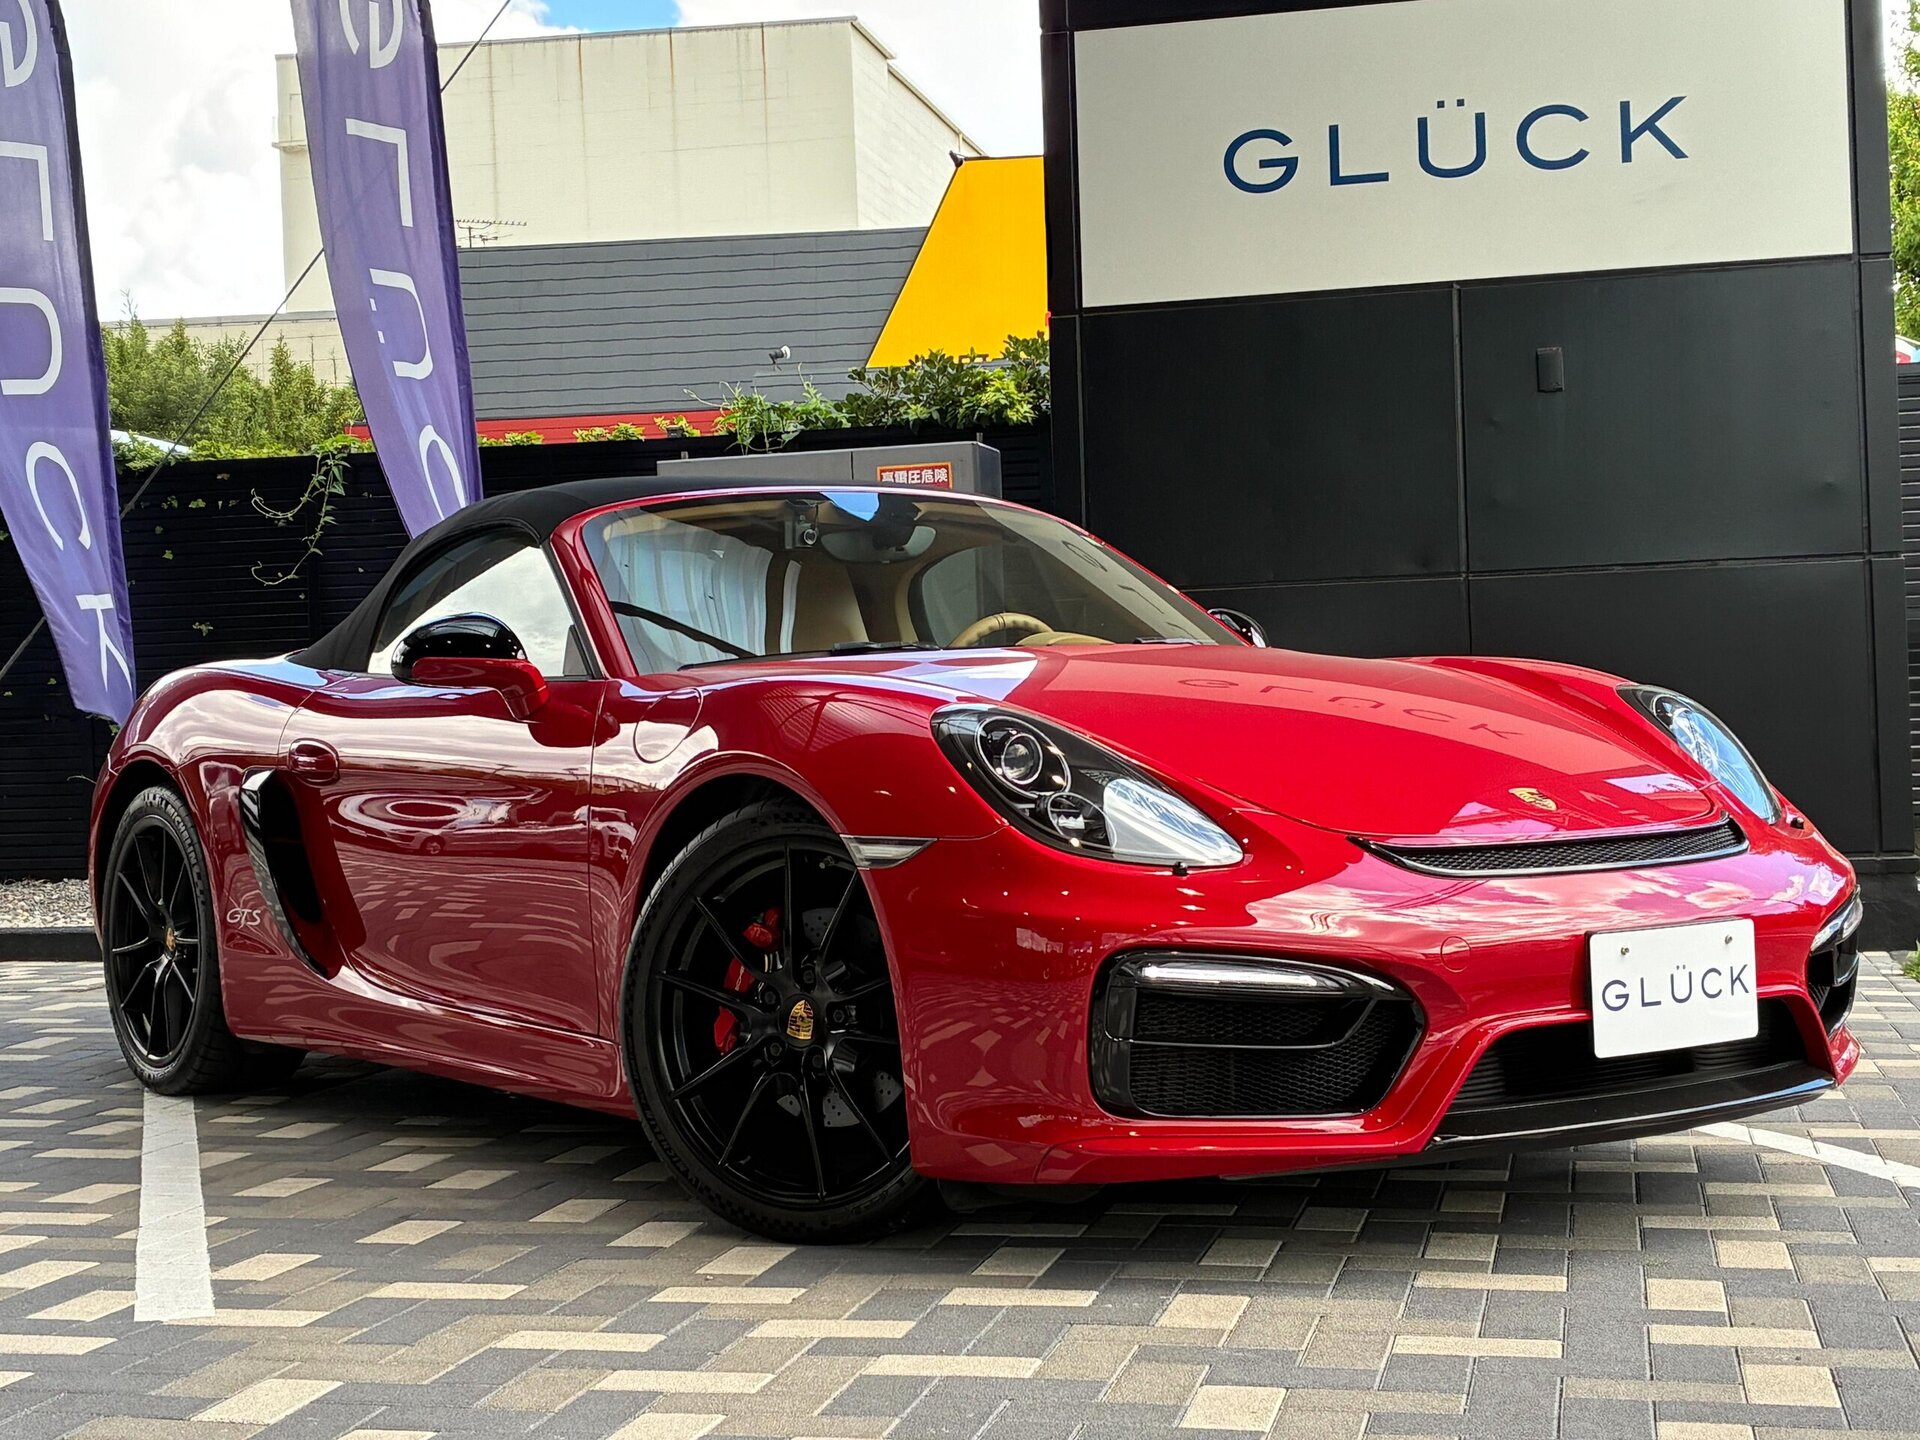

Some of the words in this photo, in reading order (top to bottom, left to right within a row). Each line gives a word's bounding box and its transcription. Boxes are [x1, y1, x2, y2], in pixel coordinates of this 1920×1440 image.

[1224, 96, 1689, 193] GLÜCK
[166, 803, 198, 866] MICHELIN
[226, 908, 262, 929] GTS
[1602, 964, 1750, 1012] GLÜCK
